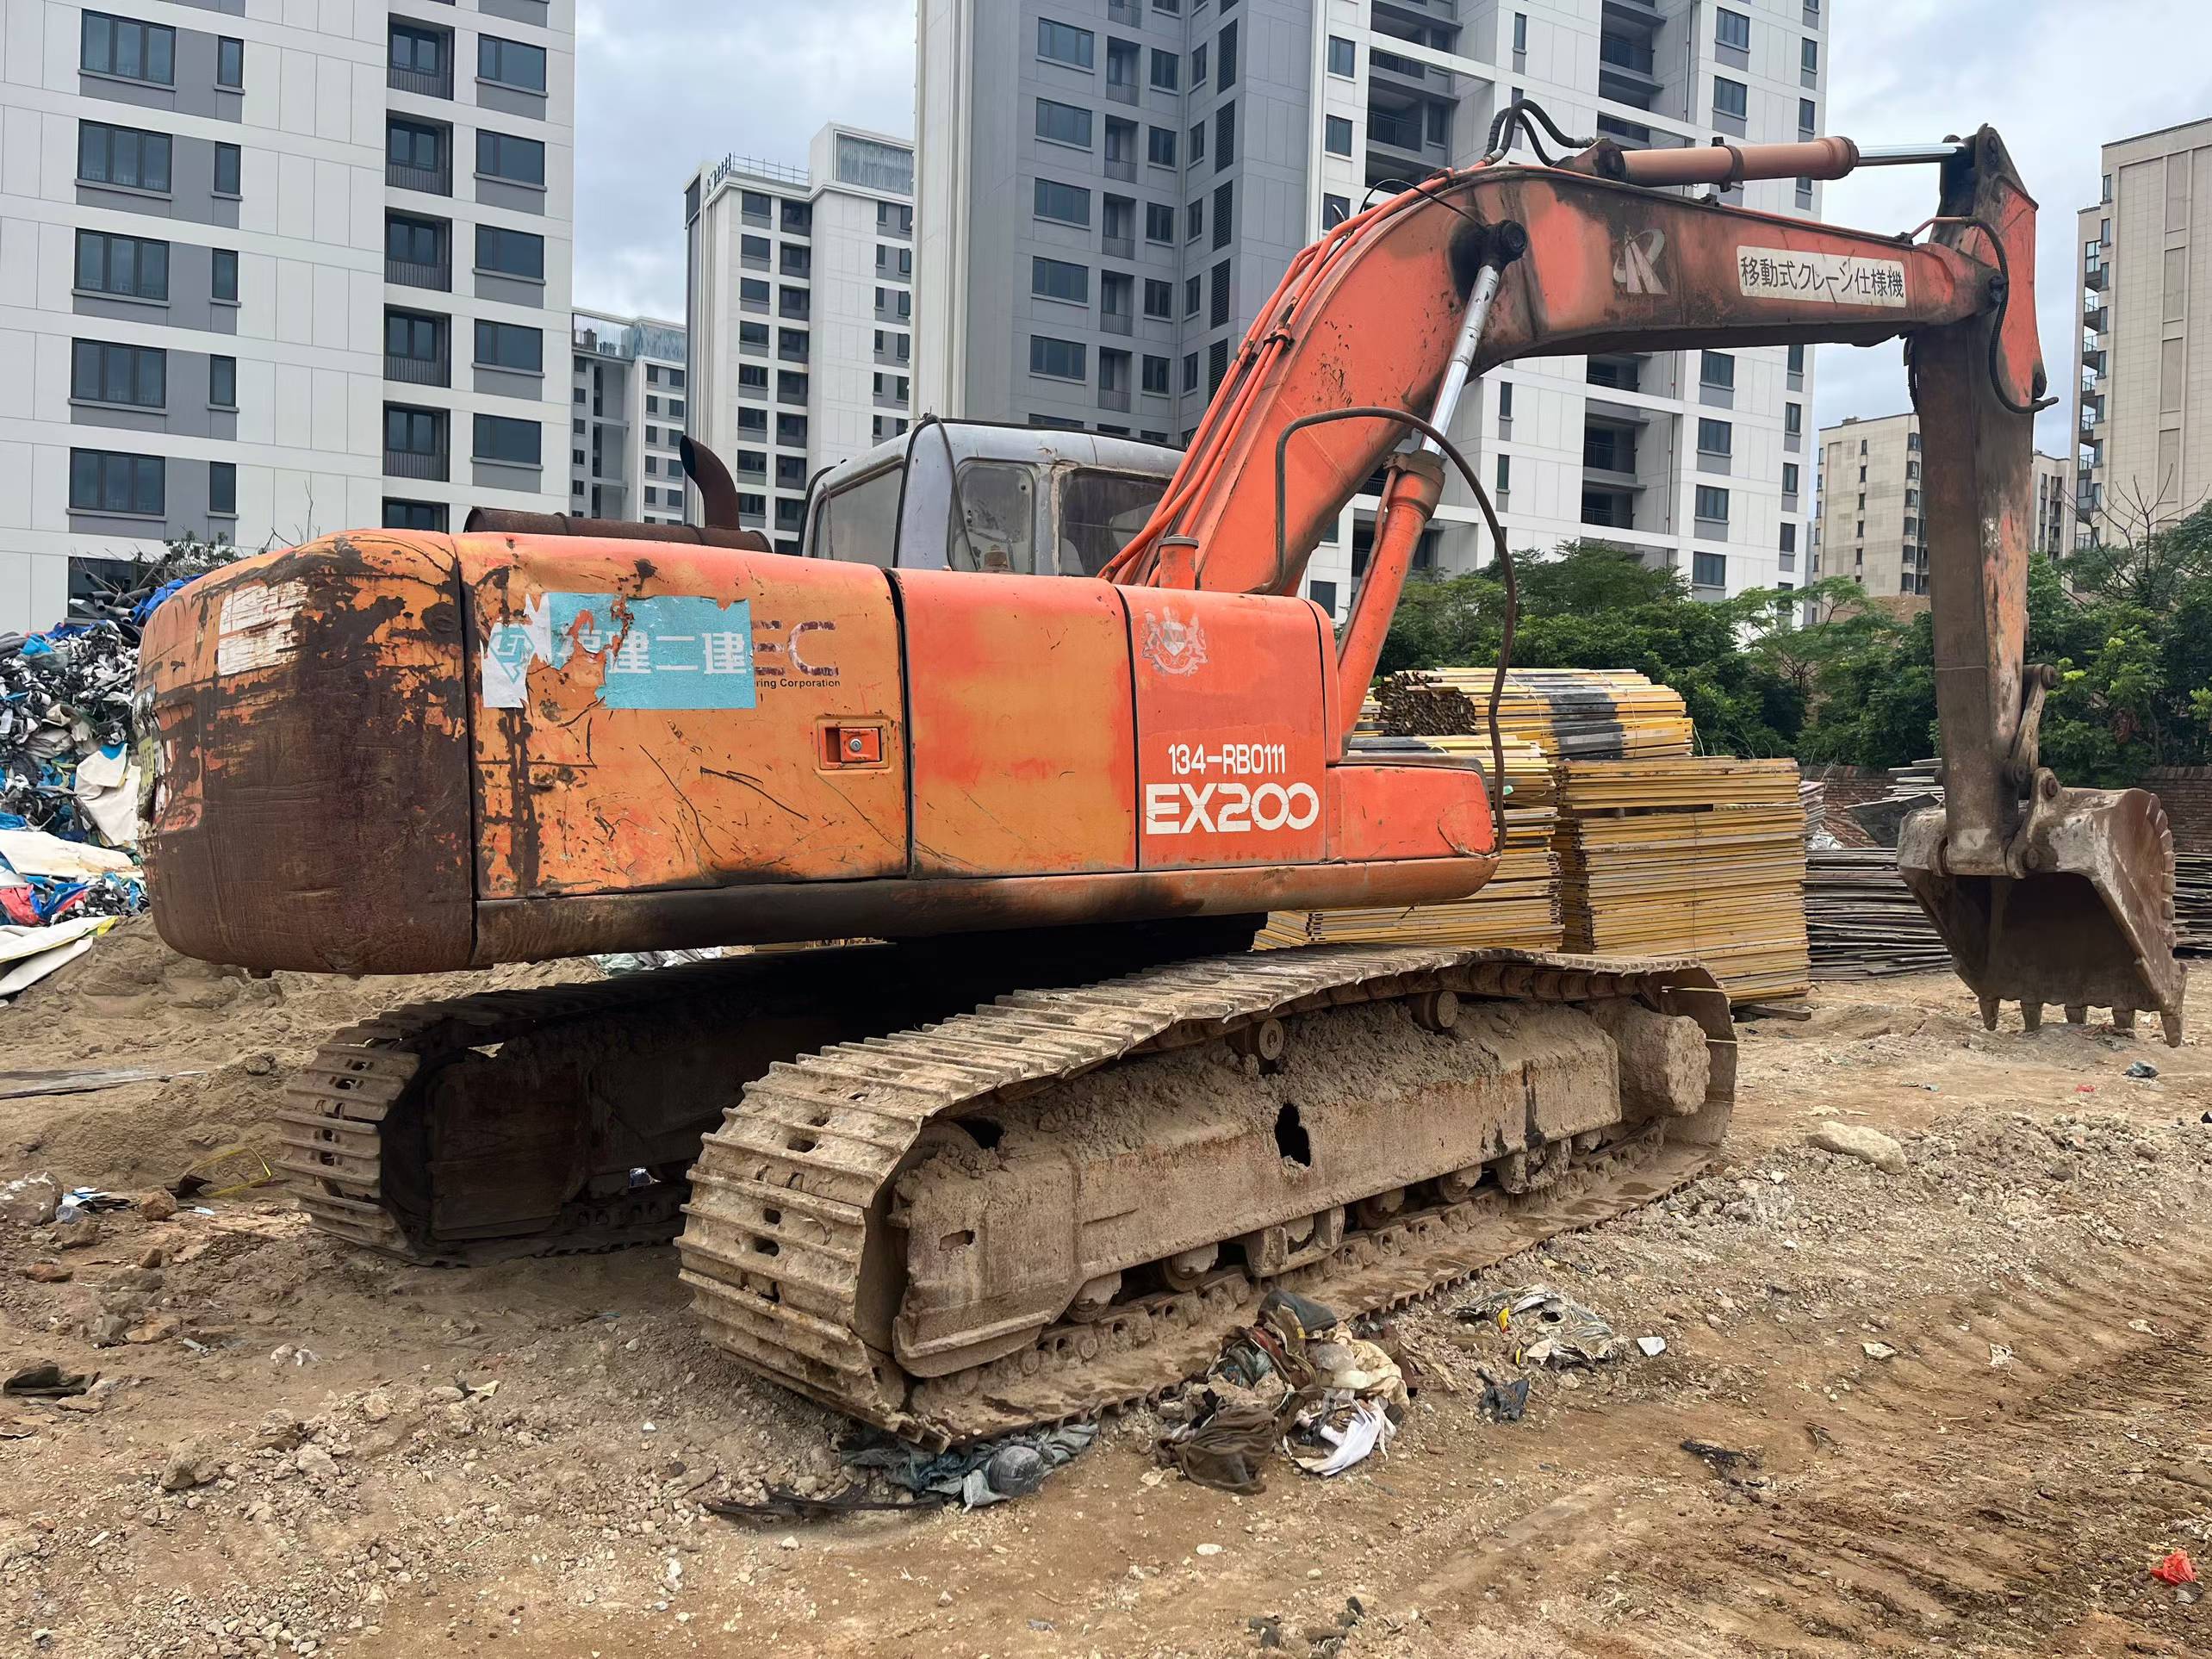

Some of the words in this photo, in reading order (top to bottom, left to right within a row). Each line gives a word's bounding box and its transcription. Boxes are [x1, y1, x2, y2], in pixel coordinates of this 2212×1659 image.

[754, 679, 777, 689] ring
[780, 678, 841, 689] Corporation
[1168, 743, 1286, 774] 134-RB0111
[1146, 782, 1320, 835] EX200
